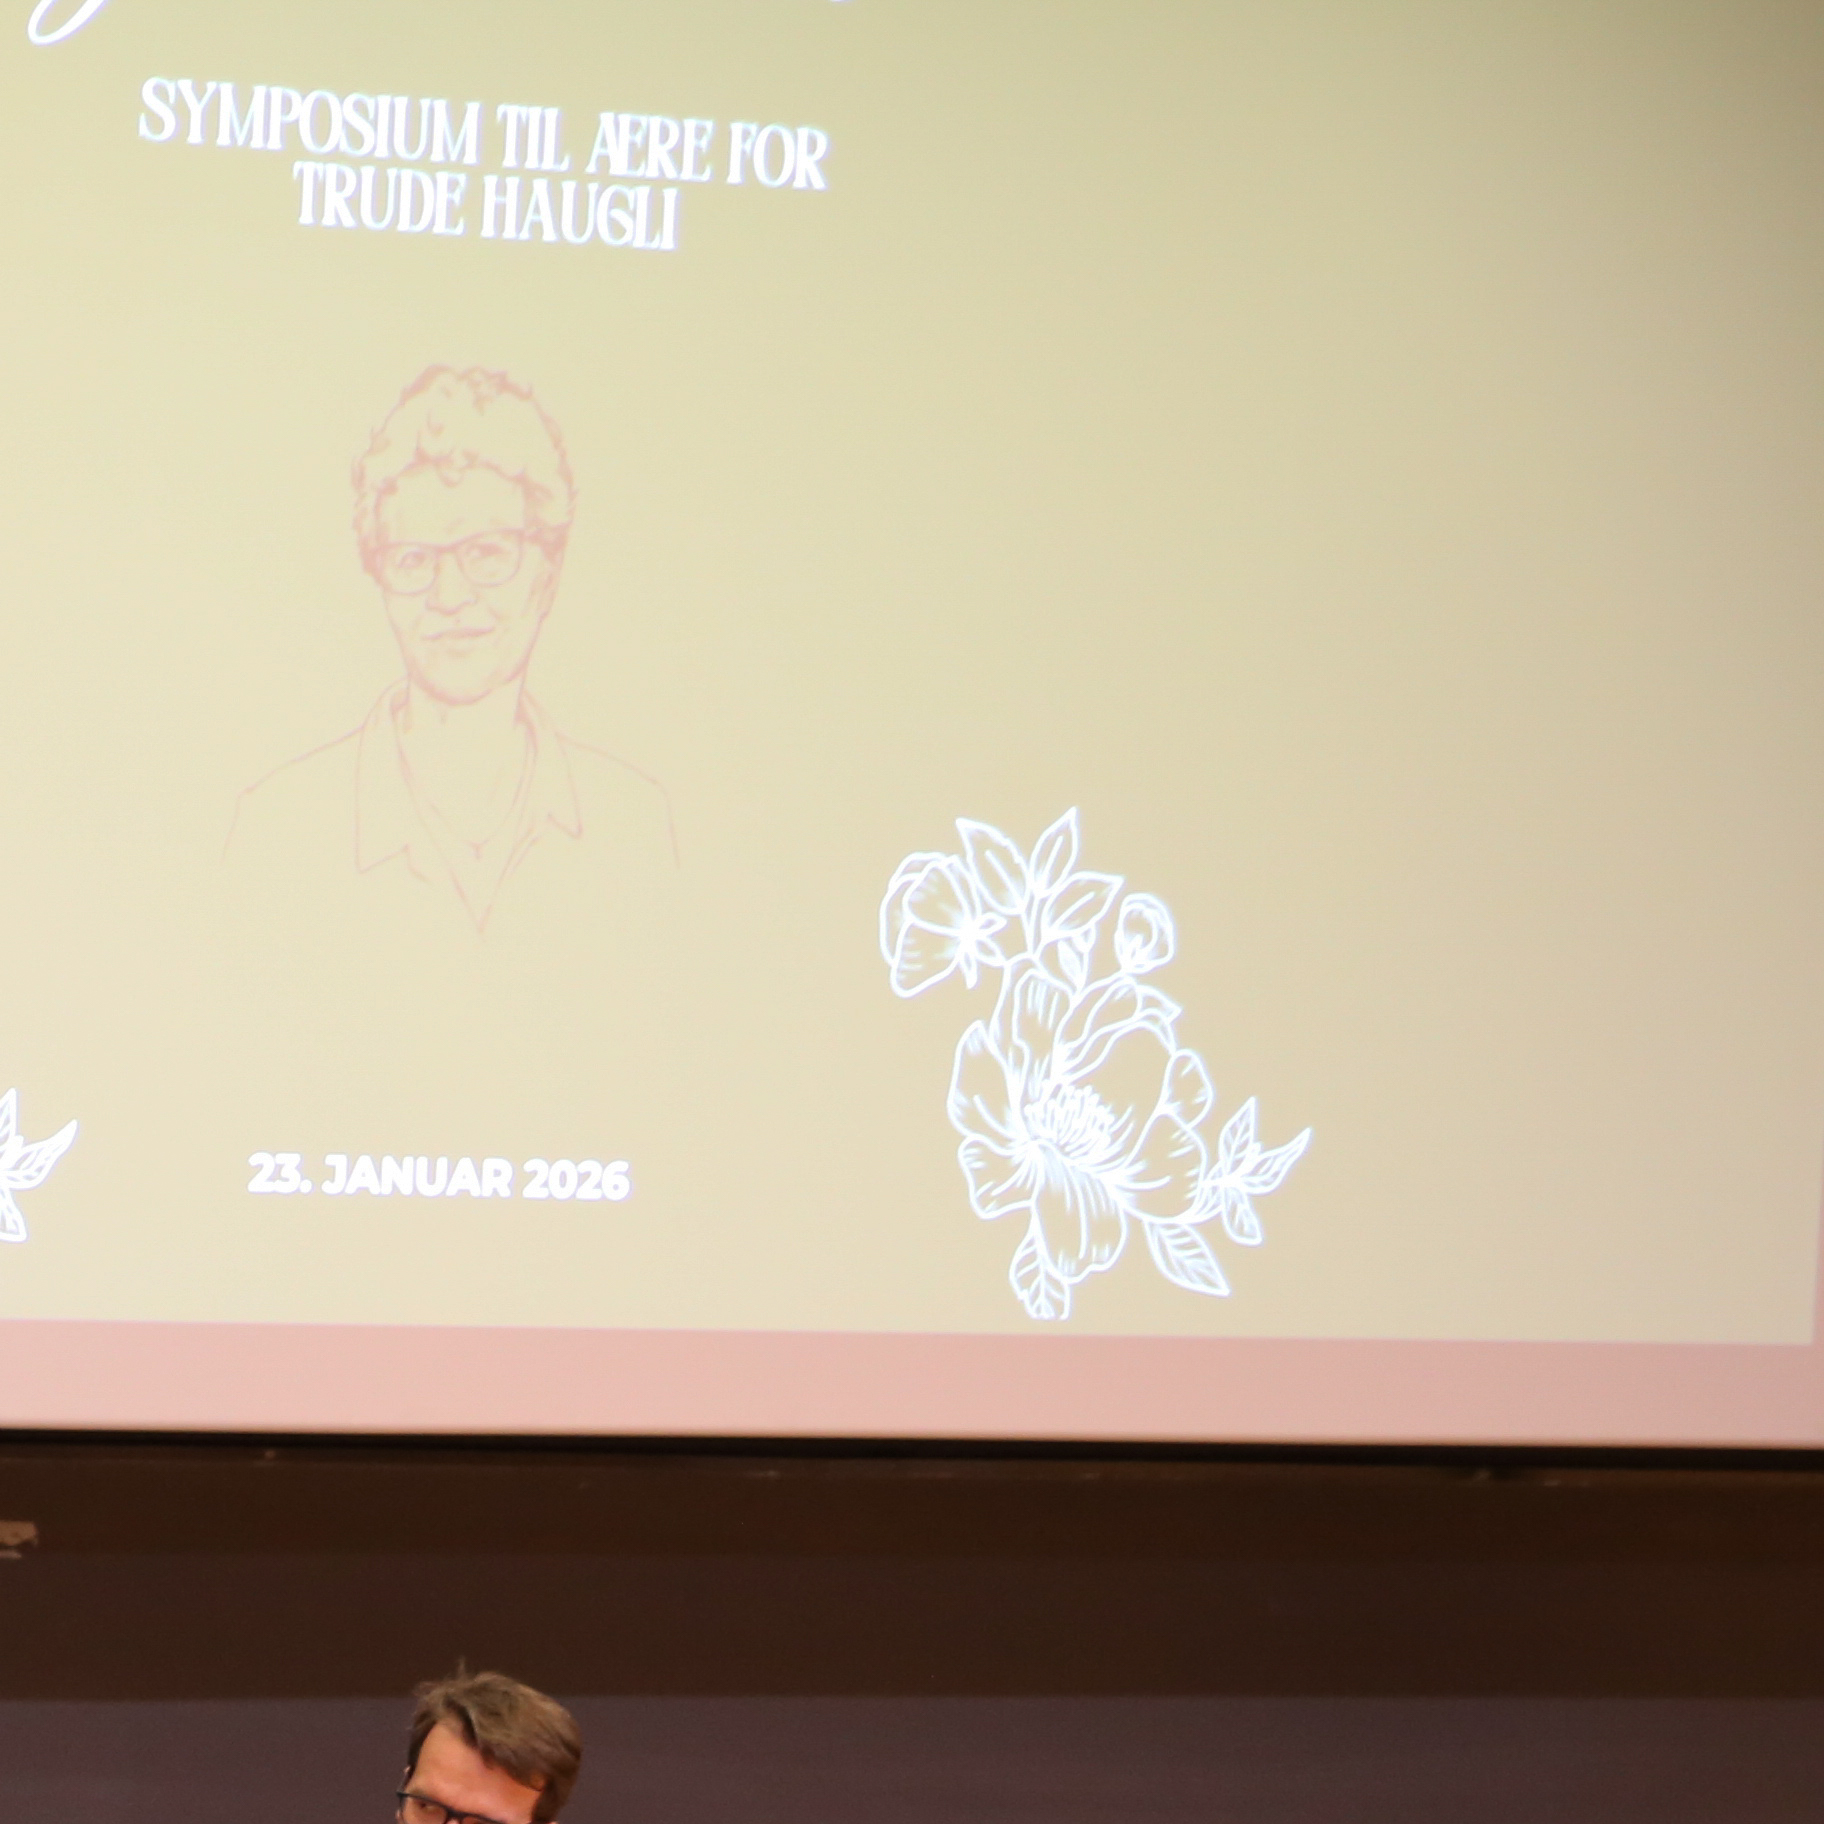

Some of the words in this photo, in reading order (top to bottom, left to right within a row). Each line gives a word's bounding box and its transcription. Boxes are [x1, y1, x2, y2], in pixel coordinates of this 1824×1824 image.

[137, 76, 481, 168] SYMPOSIUM
[495, 103, 572, 174] TIL
[584, 111, 714, 184] ÆRE
[725, 121, 830, 191] FOR
[291, 160, 468, 237] TRUDE
[478, 174, 680, 252] HAUGLI
[246, 1151, 315, 1196] 23.
[320, 1153, 515, 1199] JANUAR
[522, 1157, 633, 1203] 2026
